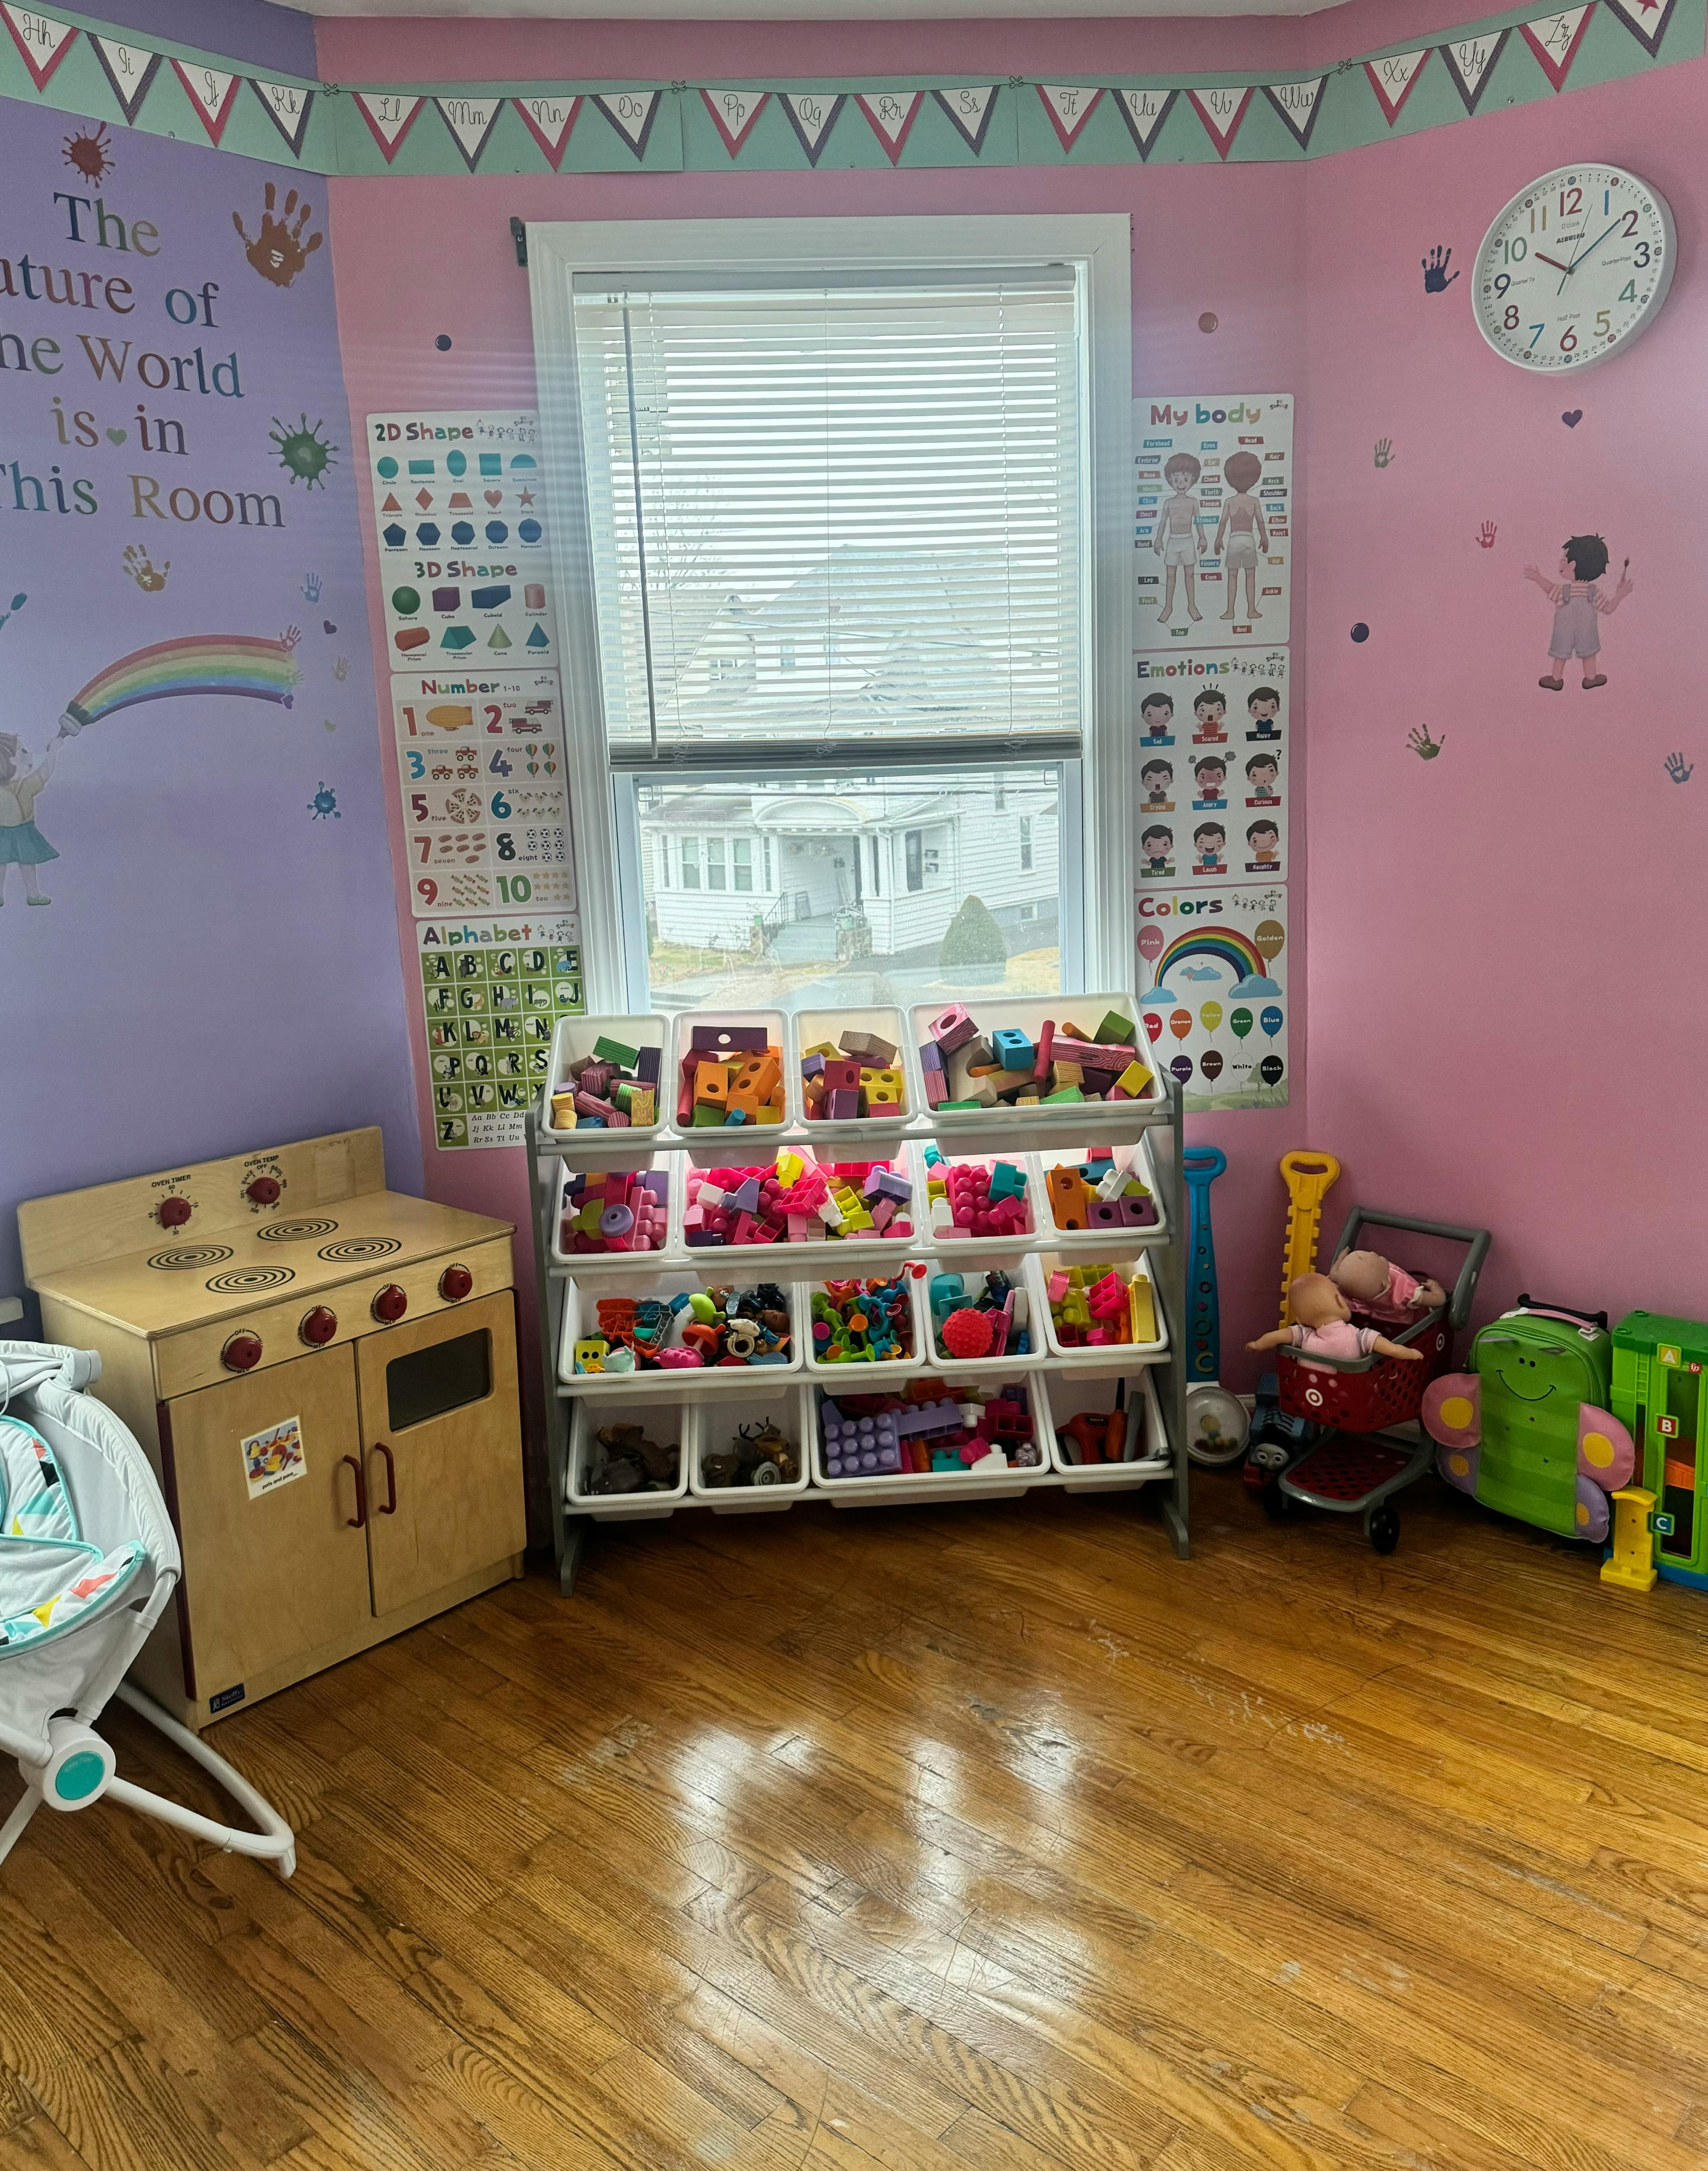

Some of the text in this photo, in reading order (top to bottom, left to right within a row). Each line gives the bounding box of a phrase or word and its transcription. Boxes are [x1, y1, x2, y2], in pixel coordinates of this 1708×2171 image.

[23, 14, 1572, 128] Hh Ii Jj Kk Ll Mm Nn Oo Pp Qq Rr Ss Tt Uu Vv Ww Xx Yy Zz
[1560, 187, 1582, 217] 12
[1604, 190, 1609, 216] 1
[54, 192, 161, 256] The
[1531, 205, 1547, 233] 11
[1621, 210, 1638, 238] 2
[1504, 236, 1527, 264] 10
[1634, 242, 1650, 268] 3
[1494, 273, 1511, 299] 9
[1618, 279, 1637, 302] 4
[165, 282, 220, 327] of
[1504, 305, 1519, 330] 8
[1593, 310, 1610, 337] 5
[1529, 323, 1545, 349] 7
[1560, 325, 1577, 351] 6
[77, 335, 245, 398] World
[51, 396, 190, 455] is in
[1151, 404, 1188, 426] My
[1196, 402, 1261, 424] body
[375, 422, 474, 441] 2D Shape
[0, 461, 286, 527] his Room
[415, 561, 518, 578] 3D Shape
[1137, 659, 1230, 678] Emotions
[421, 679, 500, 695] Number
[403, 707, 417, 736] 1
[483, 705, 503, 733] 2
[406, 751, 425, 779] 3
[489, 749, 513, 777] 4
[411, 794, 429, 822] 5
[491, 790, 512, 819] 6
[414, 836, 432, 863] 7
[496, 833, 516, 861] 8
[417, 878, 438, 906] 9
[496, 875, 531, 903] 10
[1139, 896, 1223, 917] Colors
[423, 924, 532, 946] Alphabet
[437, 956, 450, 977] A
[464, 955, 476, 975] B
[500, 953, 512, 974] C
[533, 951, 545, 972] D
[439, 989, 449, 1009] F
[460, 988, 473, 1009] G
[493, 986, 504, 1007] H
[527, 984, 533, 1005] I
[569, 983, 578, 1004] J
[443, 1022, 457, 1042] K
[465, 1021, 474, 1041] L
[450, 1058, 460, 1077] P
[476, 1055, 488, 1076] Q
[508, 1053, 521, 1073] R
[535, 1049, 548, 1069] S
[439, 1087, 451, 1107] U
[1663, 1350, 1675, 1364] A
[1662, 1420, 1672, 1432] B
[1656, 1517, 1667, 1529] C
